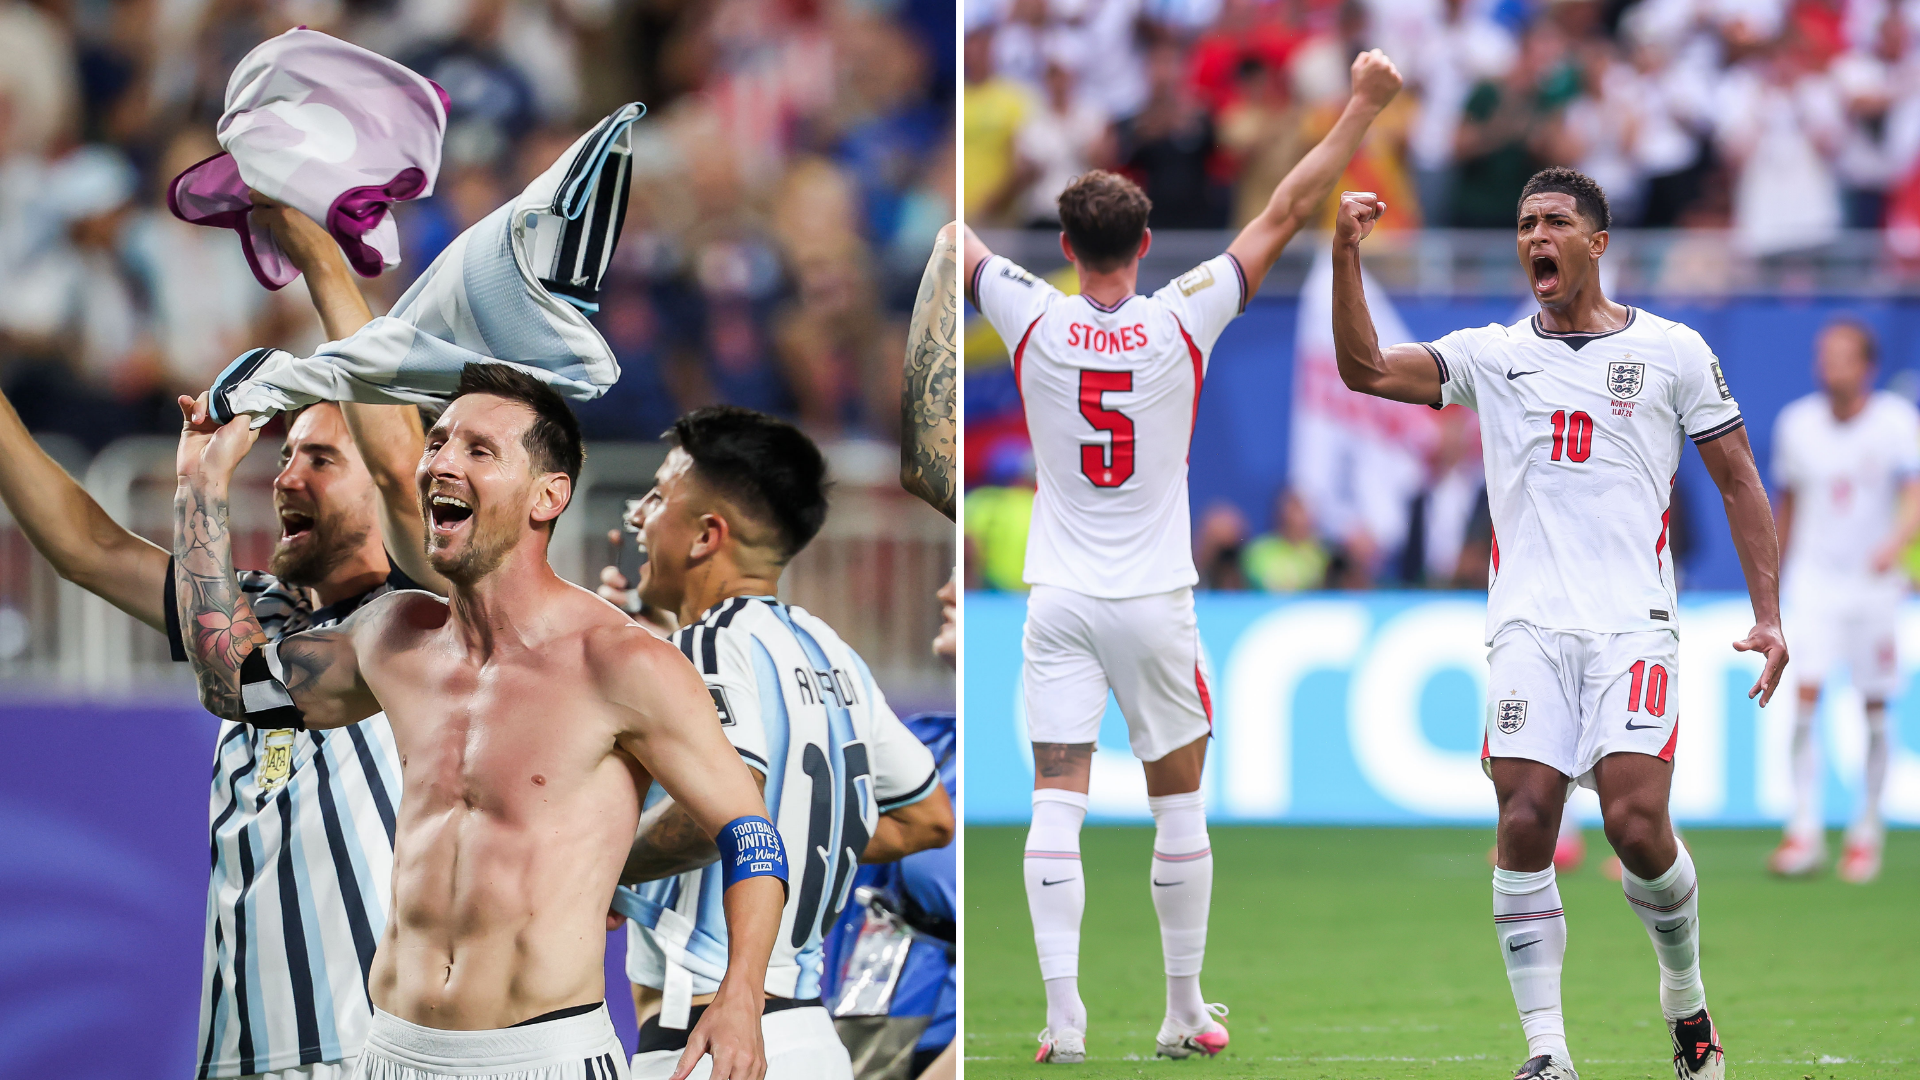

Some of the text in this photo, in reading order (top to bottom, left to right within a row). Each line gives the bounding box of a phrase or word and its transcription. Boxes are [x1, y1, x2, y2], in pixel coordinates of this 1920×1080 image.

[1068, 323, 1148, 354] STONES
[1611, 399, 1635, 410] NORWAY
[1612, 409, 1632, 418] 11.07.26
[1079, 370, 1135, 487] 5
[1551, 410, 1593, 463] 10
[1627, 659, 1668, 718] 10
[268, 746, 285, 771] AFA
[732, 821, 777, 839] FOOTBALL
[737, 832, 780, 852] UNITES
[736, 848, 783, 866] the World
[753, 863, 771, 871] FIFA
